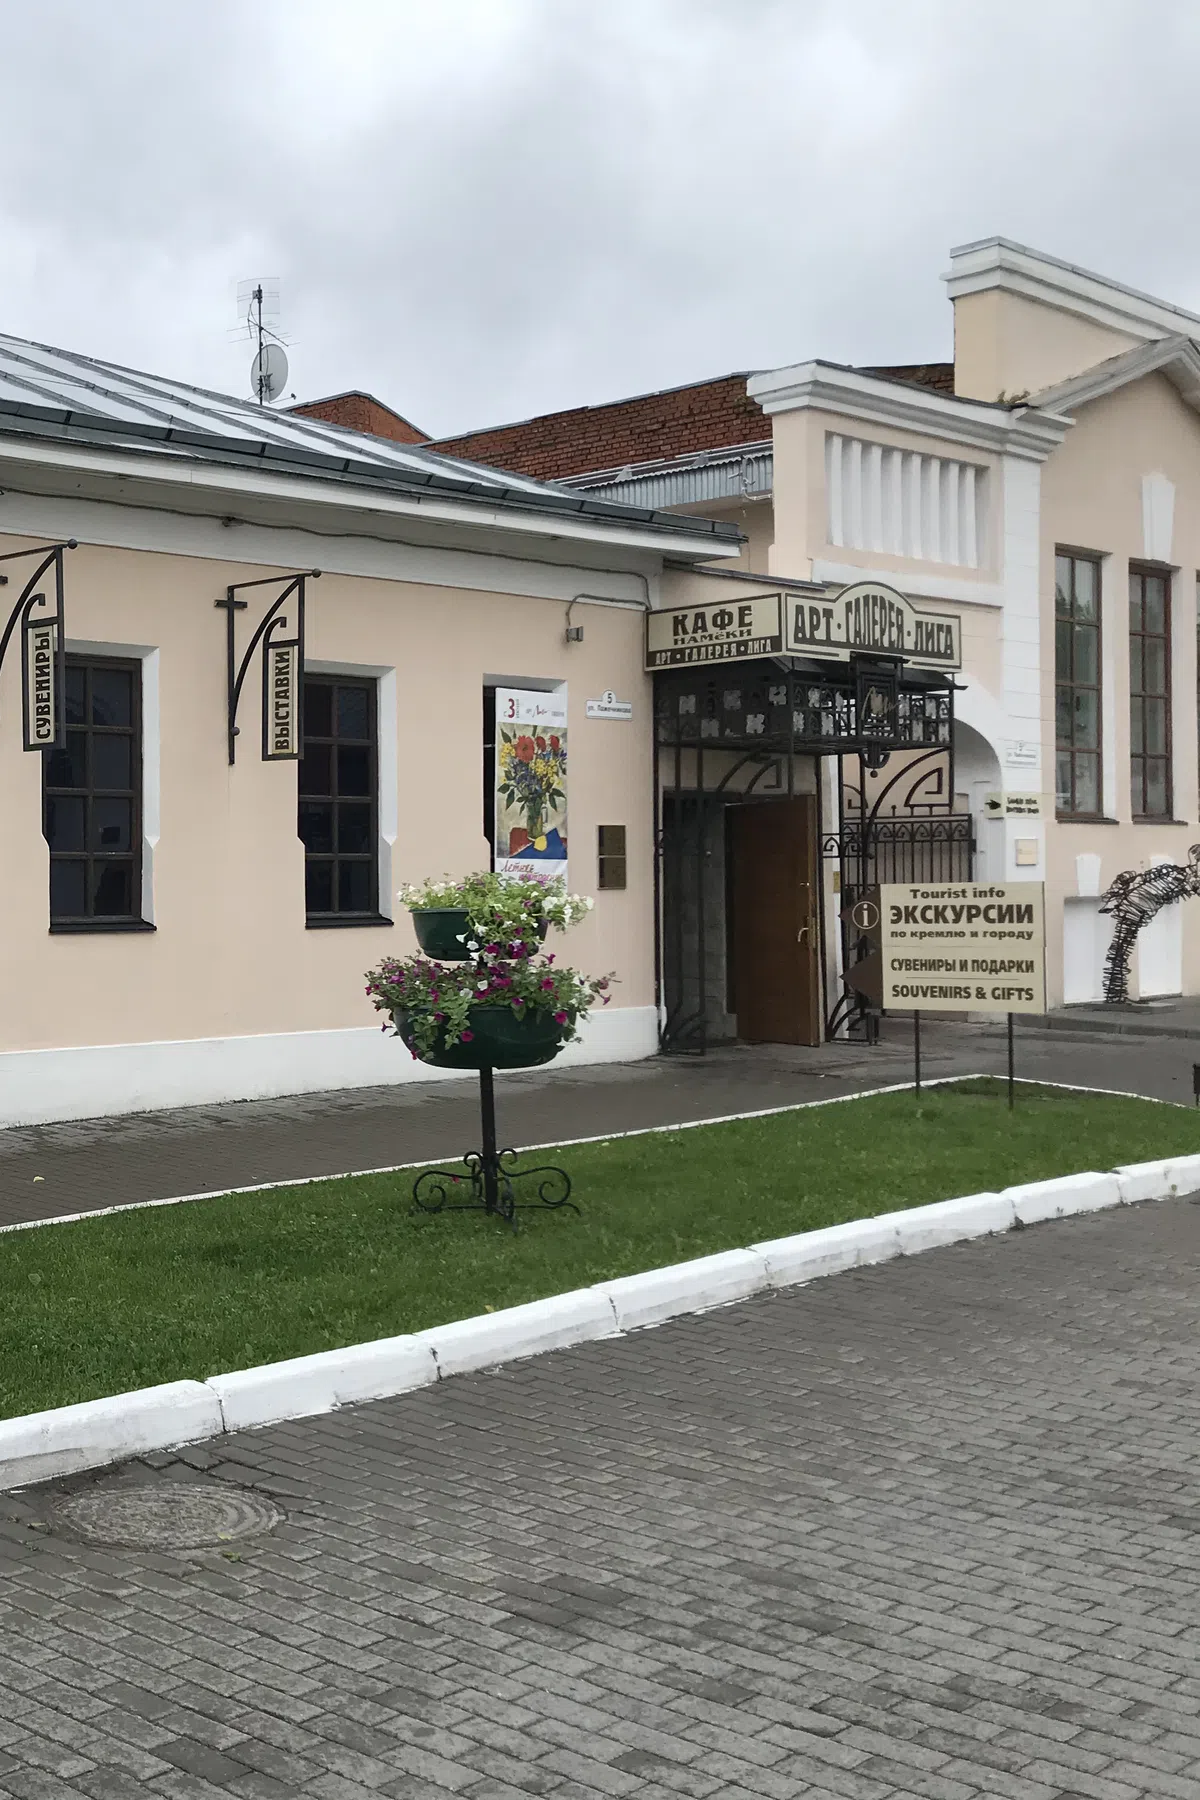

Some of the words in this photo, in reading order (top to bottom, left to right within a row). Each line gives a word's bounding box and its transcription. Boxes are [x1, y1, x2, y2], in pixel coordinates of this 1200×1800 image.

[673, 605, 753, 636] КАФЕ
[794, 604, 834, 643] АРТ
[845, 594, 904, 650] ГАЛЕРЕЯ
[914, 620, 954, 657] ЛИГА
[655, 652, 672, 665] АРТ
[685, 643, 737, 661] ГАЛЕРЕЯ
[747, 639, 771, 654] ЛИГА
[35, 631, 50, 740] СУВЕНИРЫ
[275, 650, 290, 750] ВЫСТАВКИ
[508, 698, 516, 718] 3
[607, 693, 612, 704] 5
[910, 888, 968, 899] Tourist
[973, 887, 1006, 899] info
[890, 904, 1034, 924] ЭКСКУРСИИ
[890, 930, 907, 938] по
[910, 930, 966, 940] кремлю
[969, 930, 979, 938] и
[982, 930, 1034, 940] городу
[891, 958, 956, 972] СУВЕНИРЫ
[959, 959, 968, 972] И
[971, 959, 1035, 975] ПОДАРКИ
[892, 984, 972, 999] SOUVENIRS
[975, 986, 988, 1000] &
[991, 987, 1034, 1001] GIFTS
